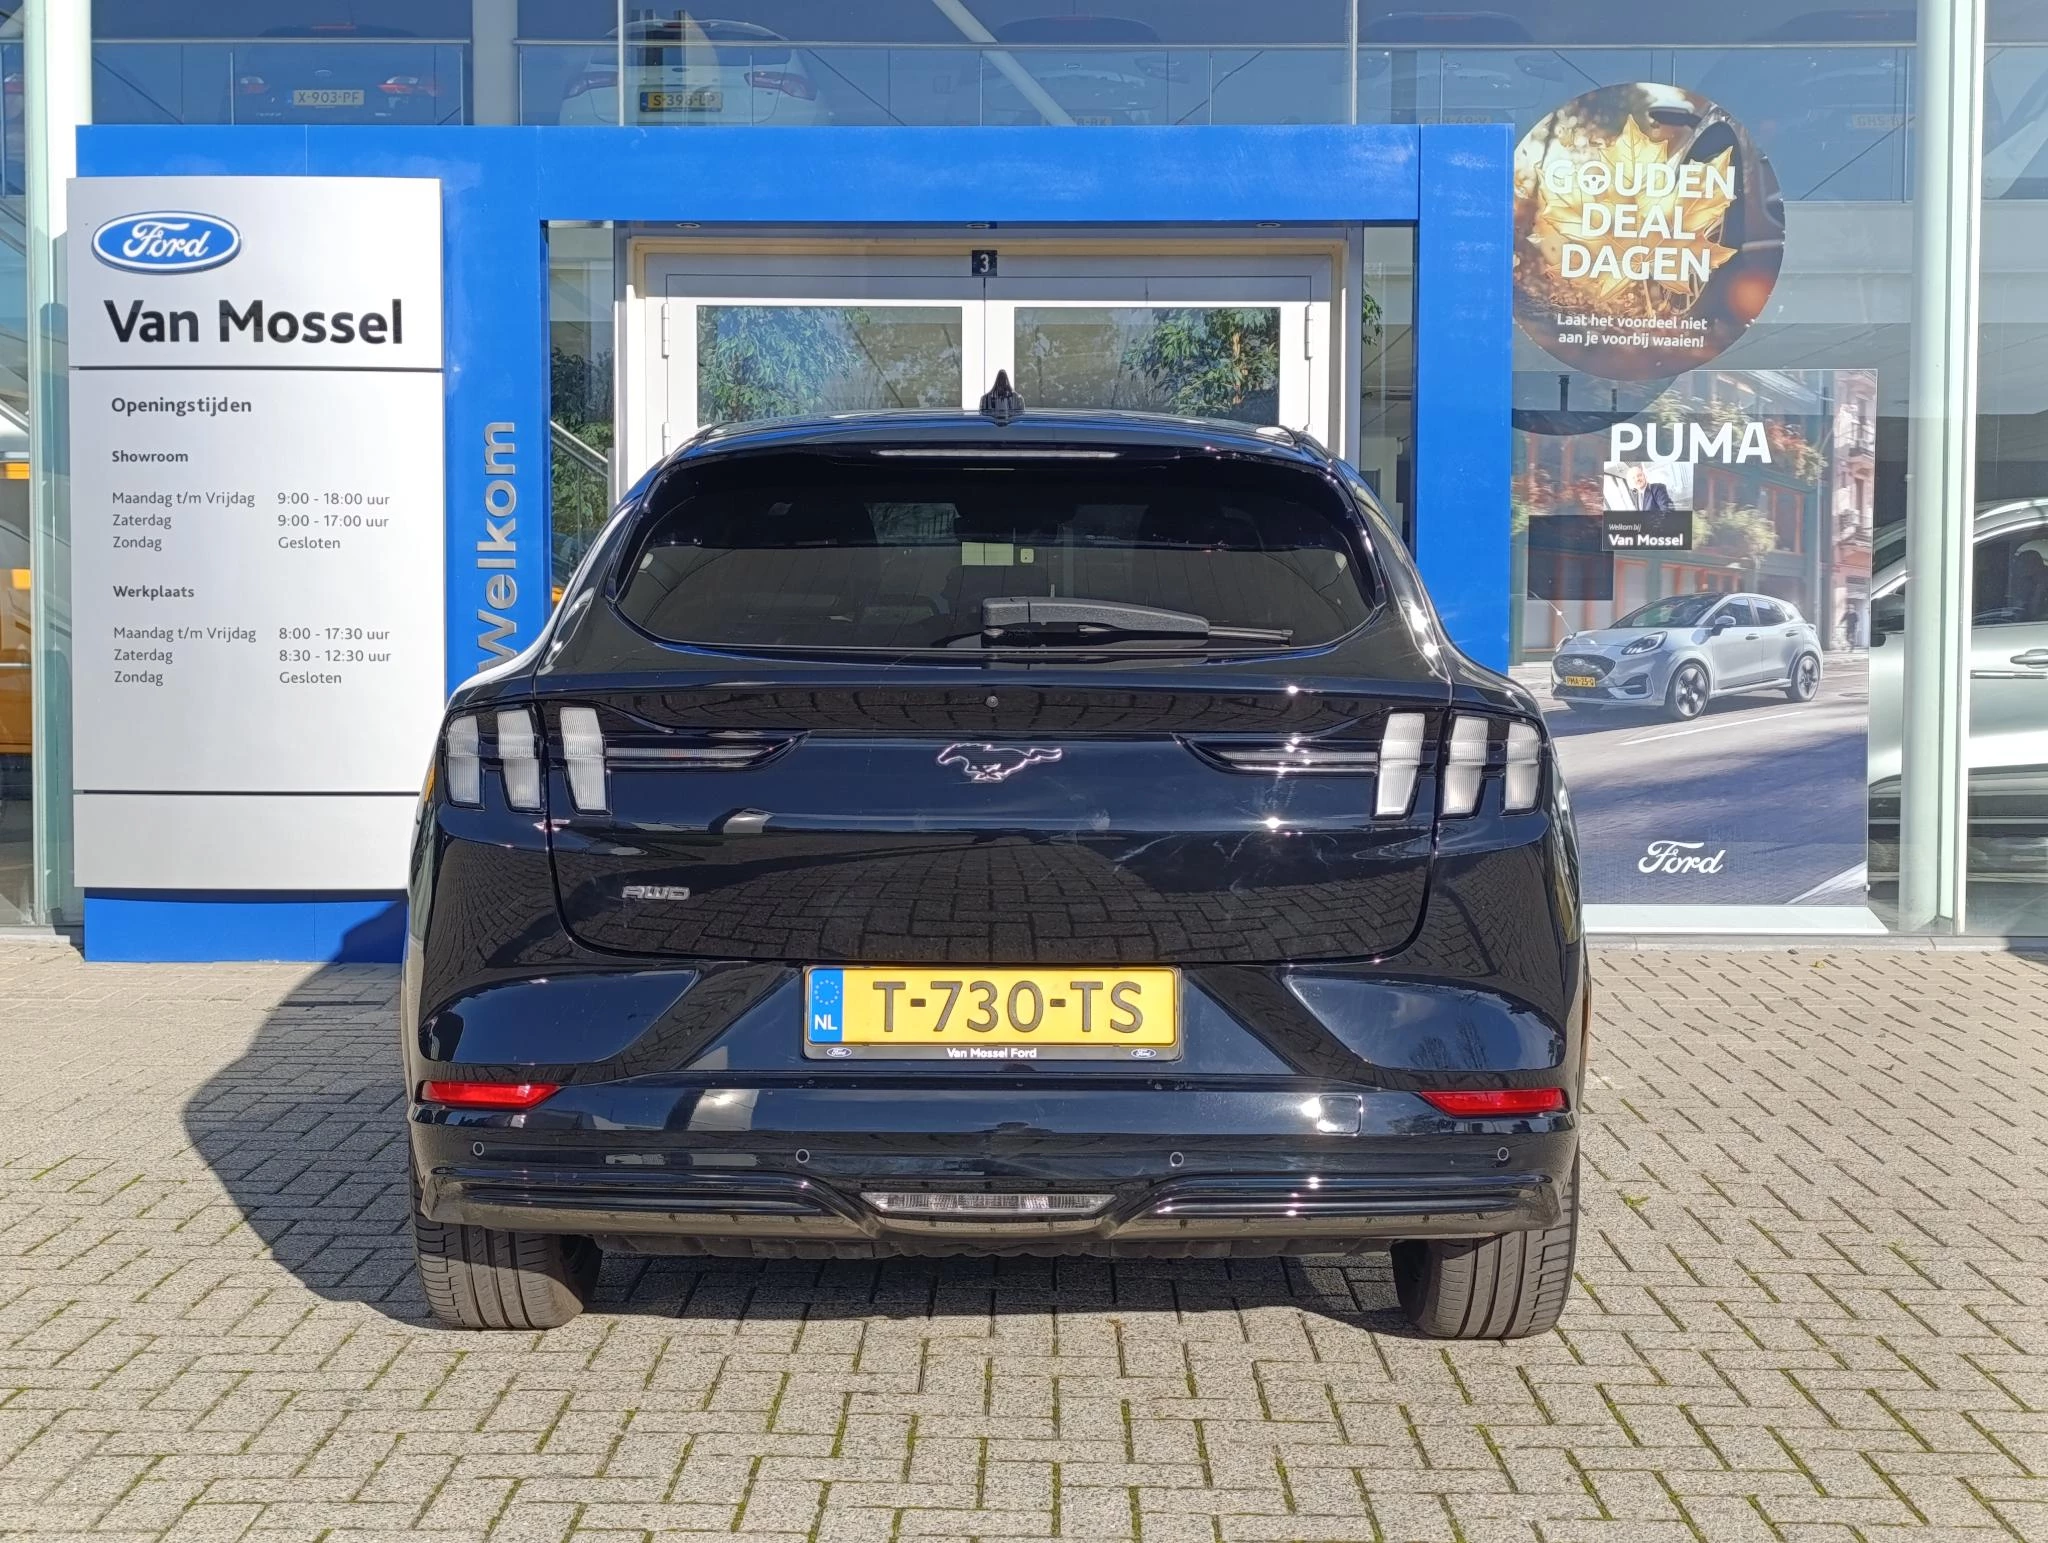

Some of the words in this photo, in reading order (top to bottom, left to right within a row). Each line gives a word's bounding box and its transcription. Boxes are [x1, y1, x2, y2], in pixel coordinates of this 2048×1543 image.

[1544, 160, 1736, 200] GOUDEN
[1581, 203, 1696, 240] DEAL
[122, 220, 212, 258] Ford
[979, 253, 990, 273] 3
[1560, 243, 1711, 282] DAGEN
[103, 299, 199, 342] Van
[218, 298, 403, 344] Mossel
[1557, 313, 1588, 327] Laat
[1590, 315, 1613, 328] het
[1617, 316, 1677, 329] voordeel
[1681, 317, 1708, 331] niet
[1558, 333, 1583, 345] aan
[1584, 331, 1599, 347] je
[1602, 333, 1649, 349] voorbij
[1652, 335, 1705, 348] waaien!
[111, 396, 252, 417] Openingstijden
[1610, 421, 1773, 465] PUMA
[111, 449, 189, 463] Showroom
[112, 491, 173, 508] Maandag
[176, 491, 202, 505] t/m
[205, 491, 256, 508] Vrijdag
[277, 492, 310, 506] 9:00
[323, 492, 363, 506] 18:00
[366, 496, 391, 506] uur
[112, 513, 172, 530] Zaterdag
[277, 514, 310, 527] 9:00
[323, 514, 362, 528] 17:00
[365, 517, 390, 528] uur
[112, 535, 163, 551] Zondag
[277, 535, 341, 549] Gesloten
[476, 421, 518, 673] Welkom
[1608, 533, 1634, 546] Van
[1637, 533, 1684, 546] Mossel
[112, 585, 195, 601] Werkplaats
[113, 626, 175, 643] Maandag
[177, 626, 203, 640] t/m
[206, 626, 257, 643] Vrijdag
[278, 627, 311, 640] 8:00
[324, 627, 363, 641] 17:30
[366, 631, 391, 641] uur
[113, 648, 174, 664] Zaterdag
[278, 649, 311, 662] 8:30
[324, 649, 364, 662] 12:30
[368, 652, 392, 662] uur
[114, 670, 164, 686] Zondag
[279, 671, 342, 685] Gesloten
[1638, 840, 1727, 874] Ford
[621, 885, 691, 901] AWD
[814, 1014, 838, 1031] NL
[872, 979, 1144, 1034] T-730-TS
[946, 1047, 968, 1058] Van
[970, 1047, 1008, 1058] Mossel
[1010, 1047, 1037, 1058] Ford
